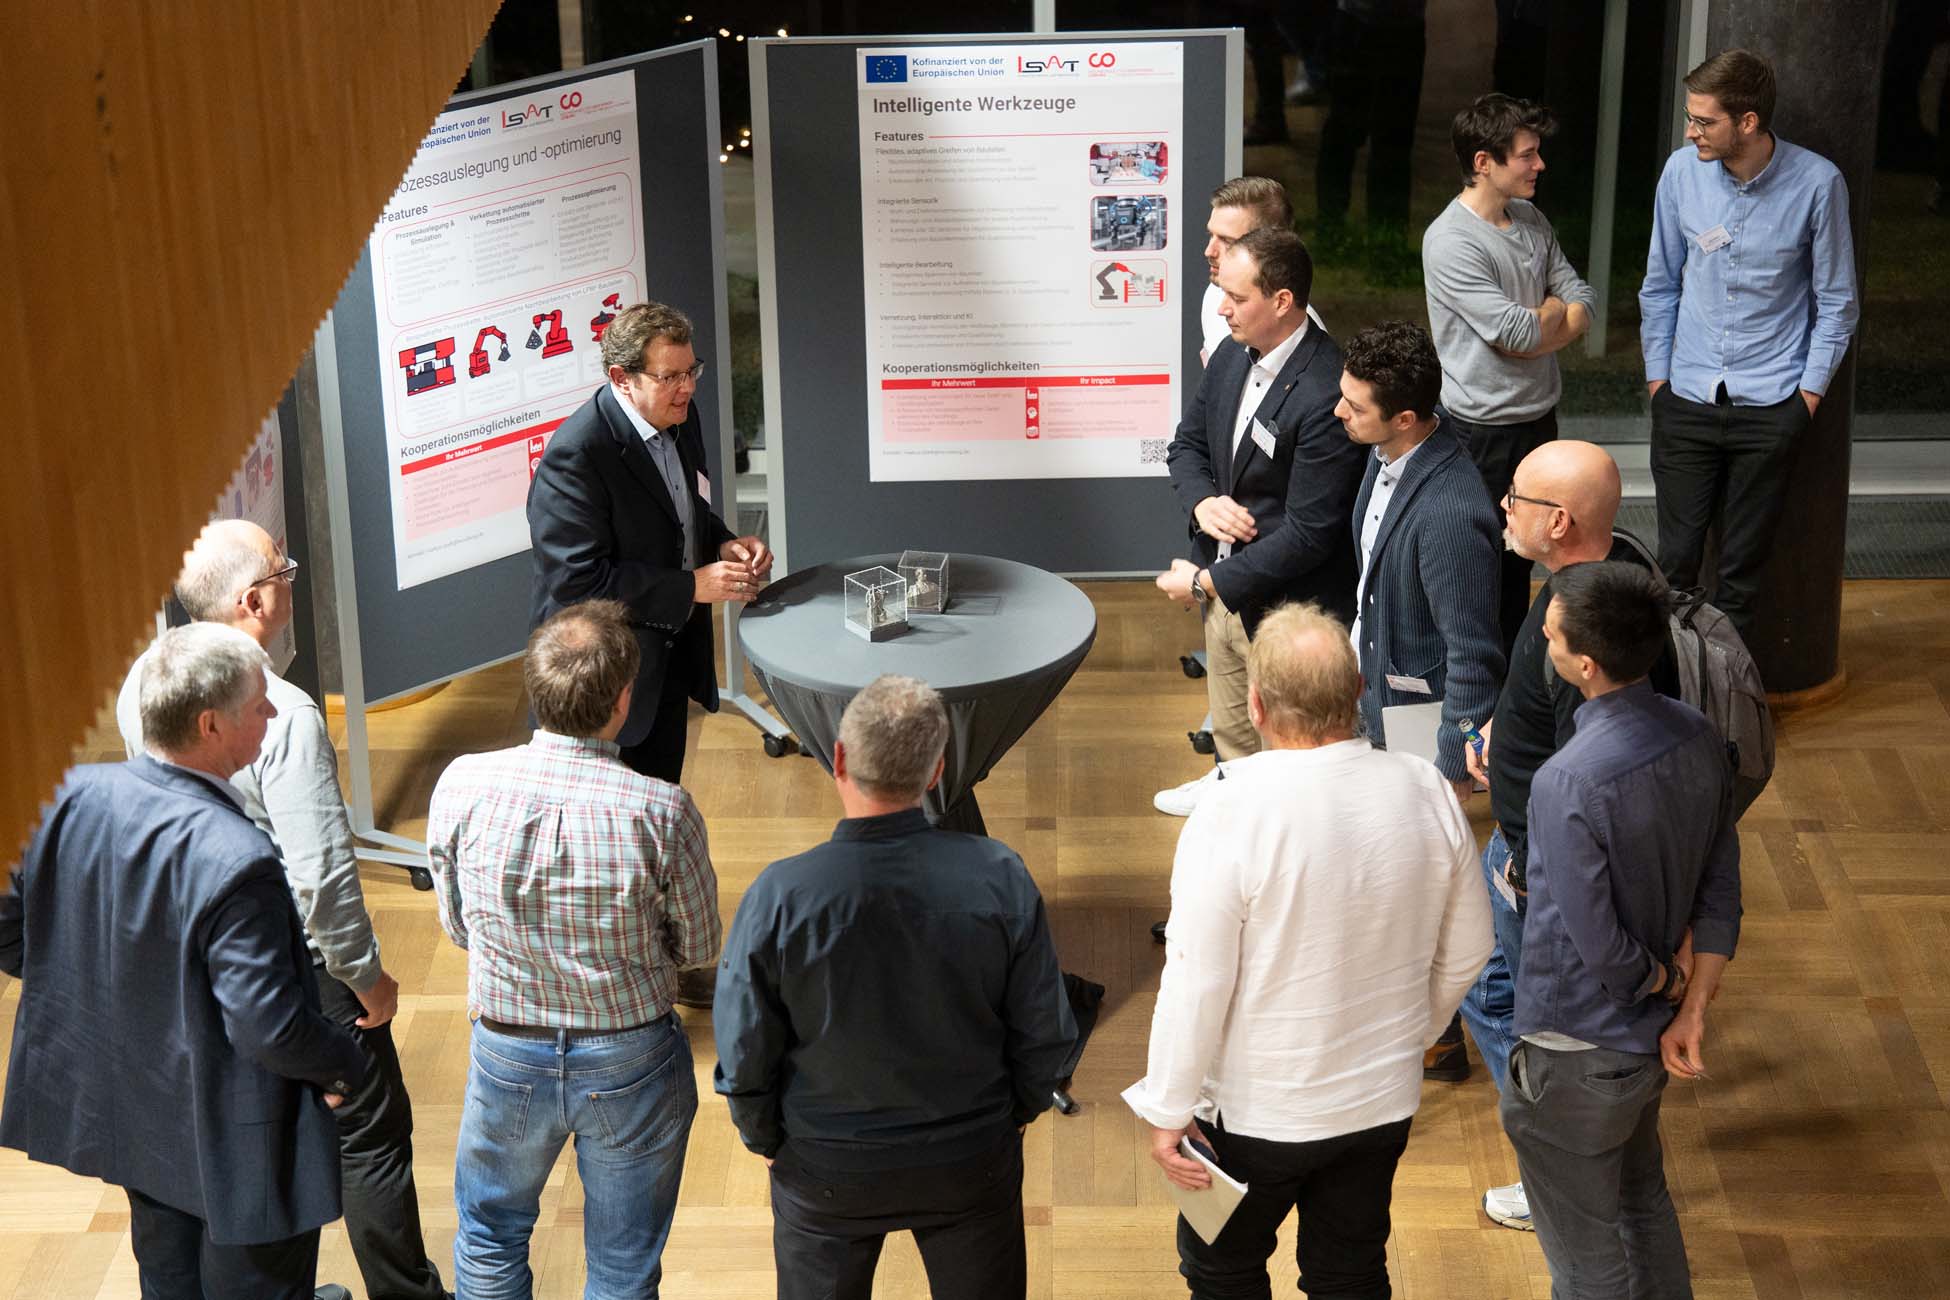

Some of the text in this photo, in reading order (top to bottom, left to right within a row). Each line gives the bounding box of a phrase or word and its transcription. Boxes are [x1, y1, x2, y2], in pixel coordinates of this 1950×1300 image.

[912, 57, 967, 66] Kofinanziert
[989, 57, 1004, 65] der
[912, 68, 1005, 78] Europäischen Union
[873, 96, 1076, 116] Intelligente Werkzeuge
[430, 115, 490, 135] anziert von der
[421, 127, 492, 149] ropäischen Union
[874, 131, 924, 142] Features
[399, 129, 622, 193] ozessauslegung und -optimierung
[382, 205, 429, 224] Features
[915, 261, 953, 269] Bearbeitung
[882, 361, 1040, 375] Kooperationsmöglichkeiten
[931, 379, 976, 388] Ihr Mehrwert
[1080, 376, 1116, 386] Ihr Impact
[400, 410, 541, 458] Kooperationsmöglichkeiten
